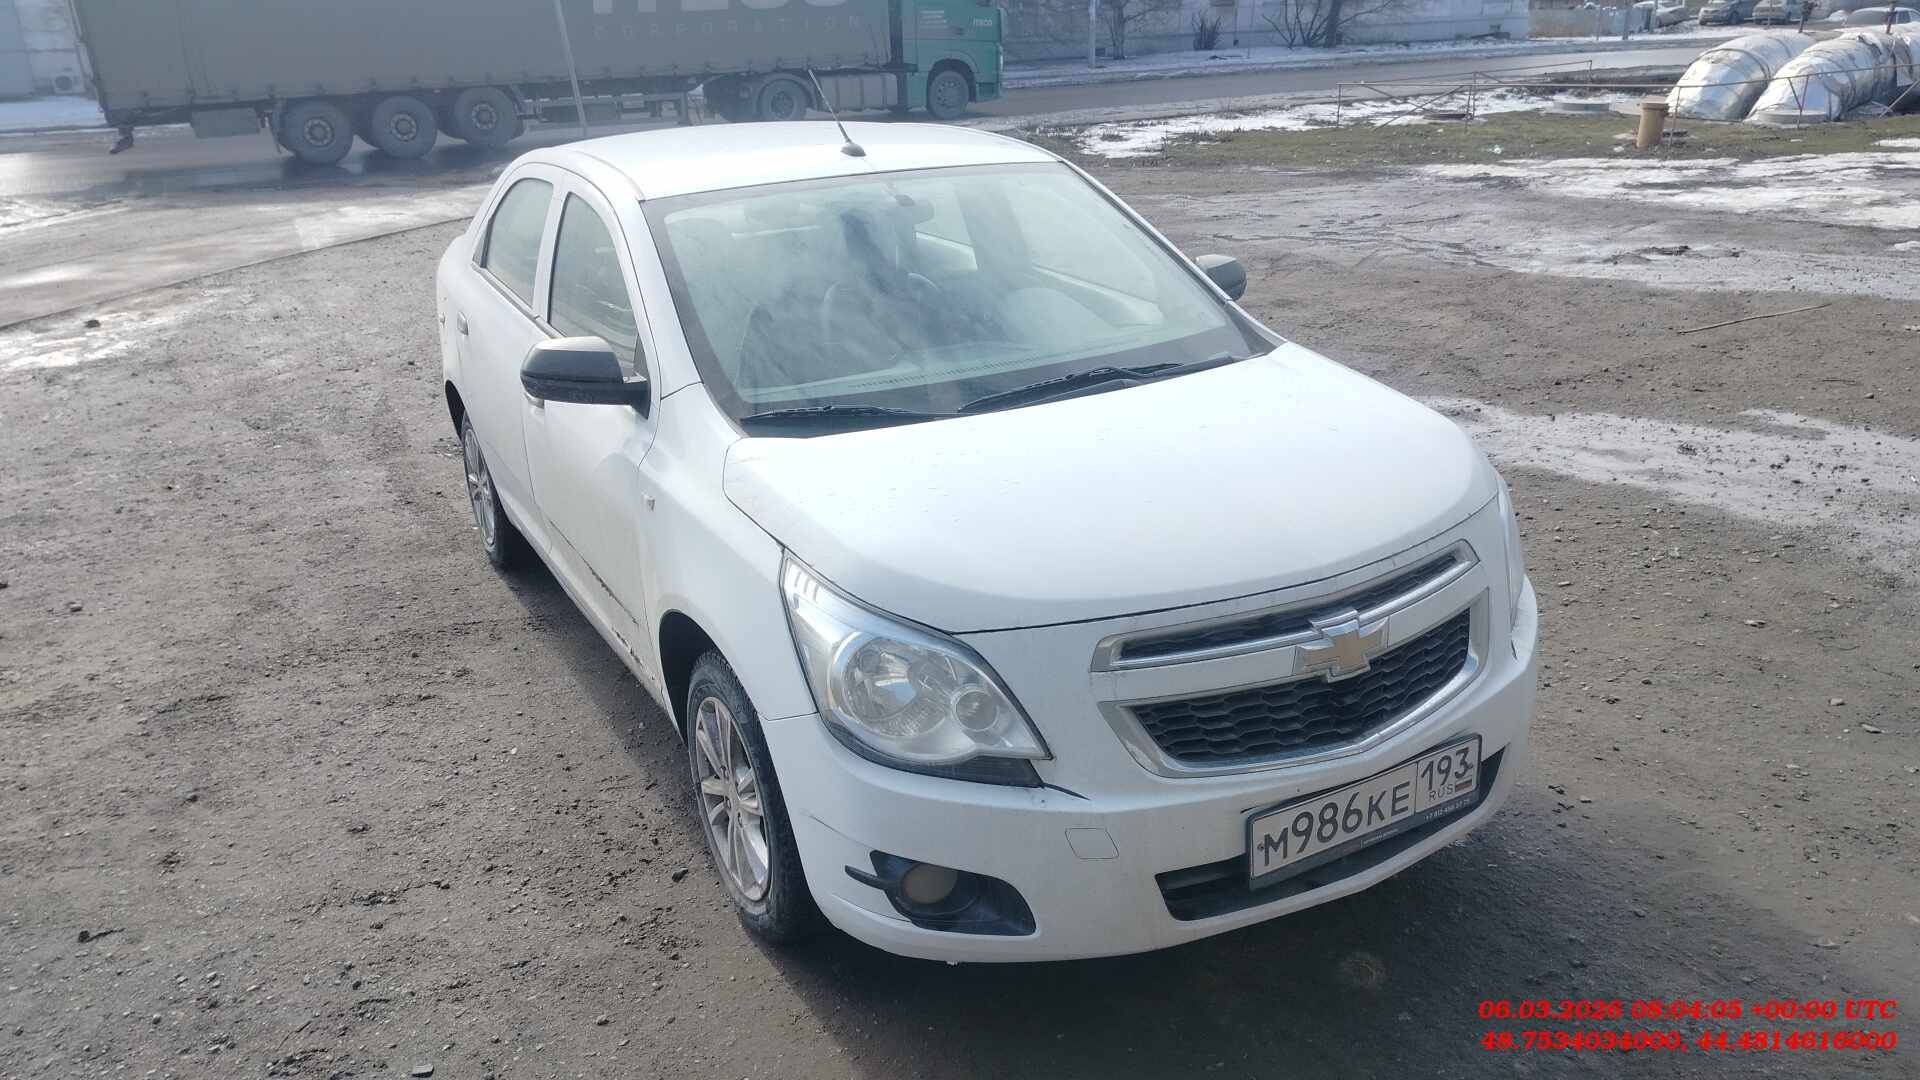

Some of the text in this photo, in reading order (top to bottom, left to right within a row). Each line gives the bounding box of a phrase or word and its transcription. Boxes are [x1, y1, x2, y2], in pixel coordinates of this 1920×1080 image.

[592, 15, 862, 40] CORPORATION
[1420, 747, 1475, 791] 193
[1428, 784, 1454, 802] RUS
